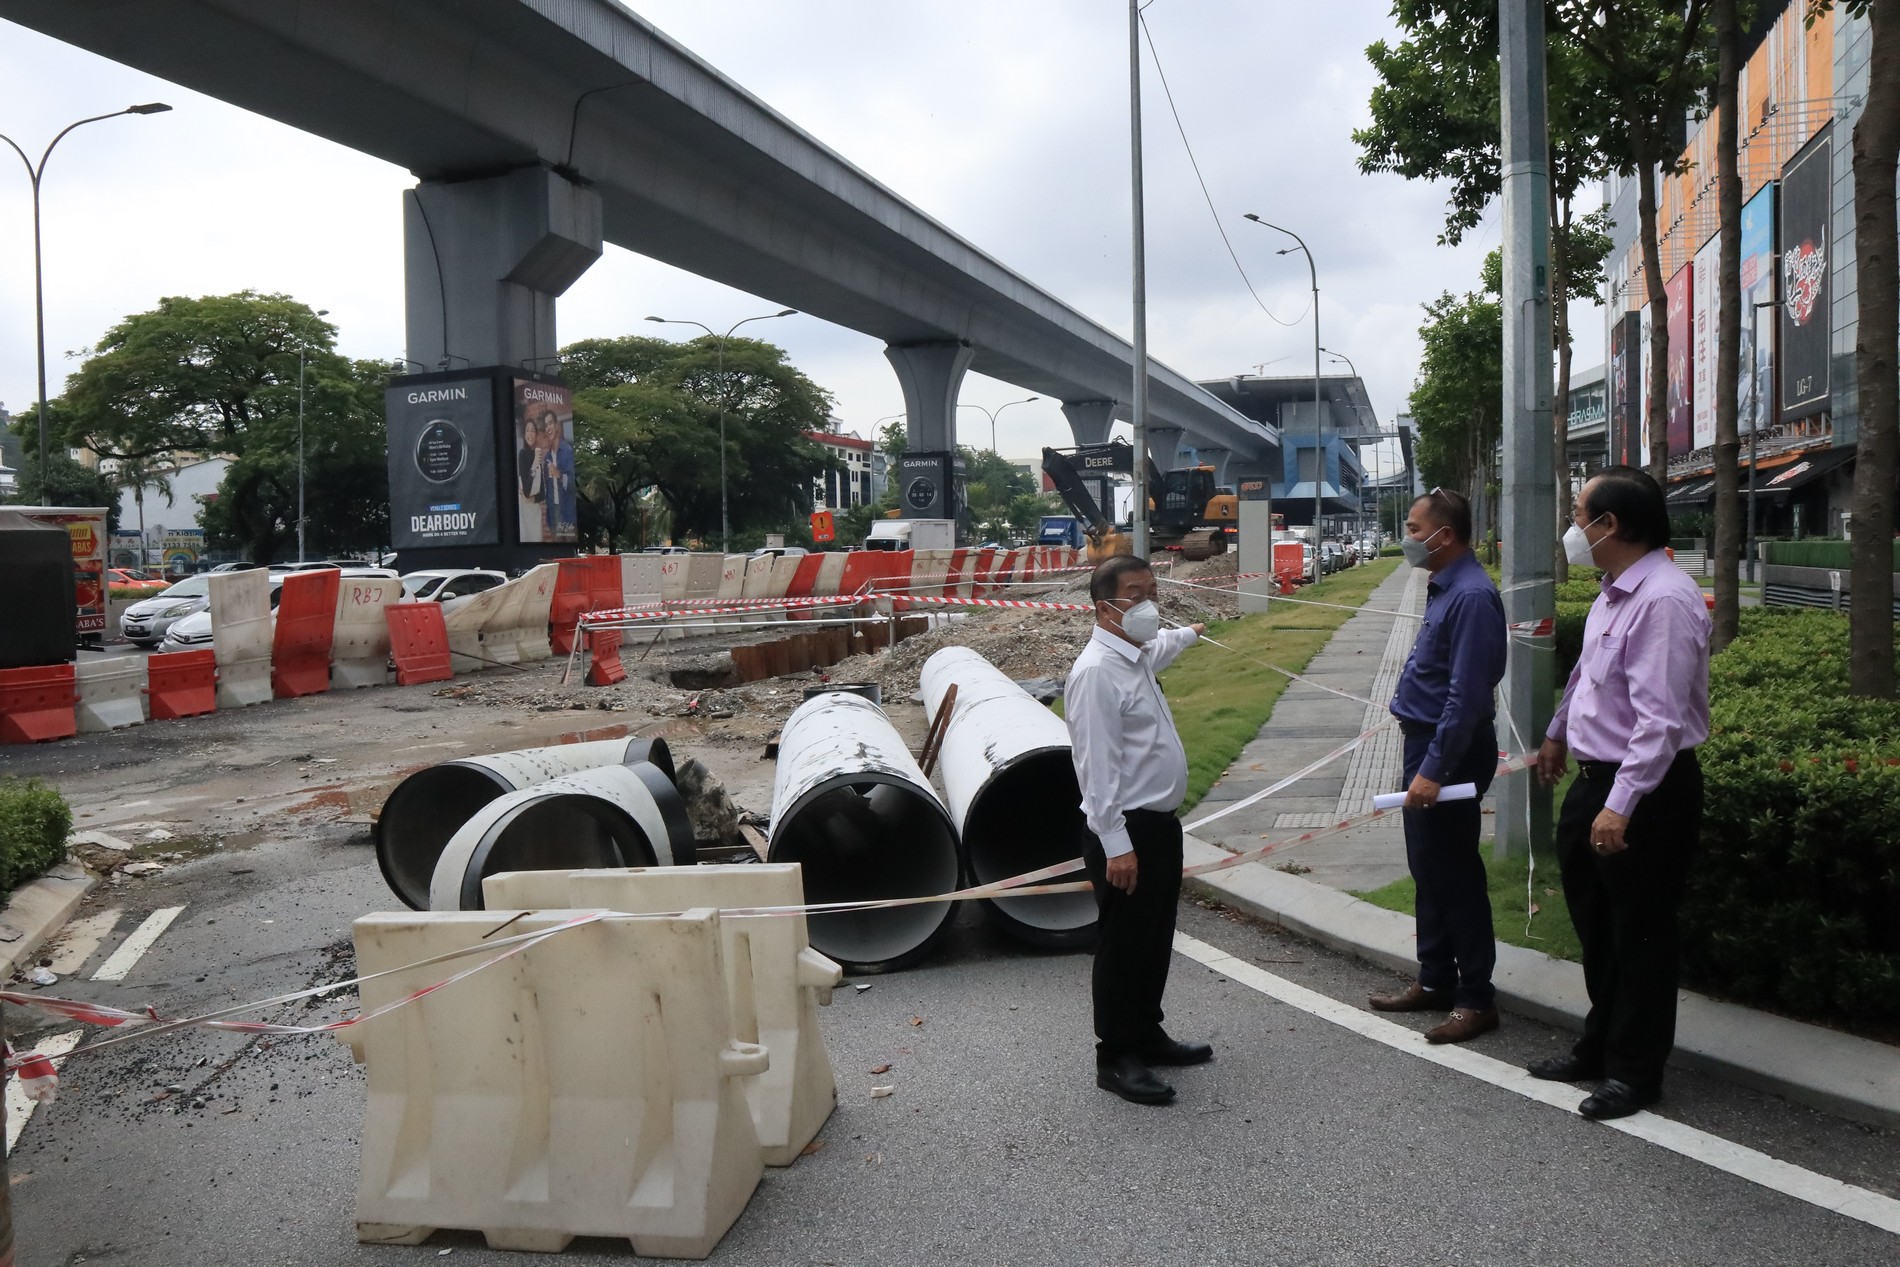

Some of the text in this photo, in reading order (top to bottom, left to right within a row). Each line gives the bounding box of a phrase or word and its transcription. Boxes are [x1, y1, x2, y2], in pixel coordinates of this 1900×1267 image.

[1796, 375, 1813, 397] LG-7
[408, 387, 467, 404] GARMIN
[524, 387, 564, 405] GARMIN
[903, 460, 938, 468] GARMIN
[1085, 457, 1113, 468] DEERE
[411, 512, 477, 532] DEAR BODY
[72, 541, 92, 553] ABAS
[76, 618, 104, 629] ABA'S
